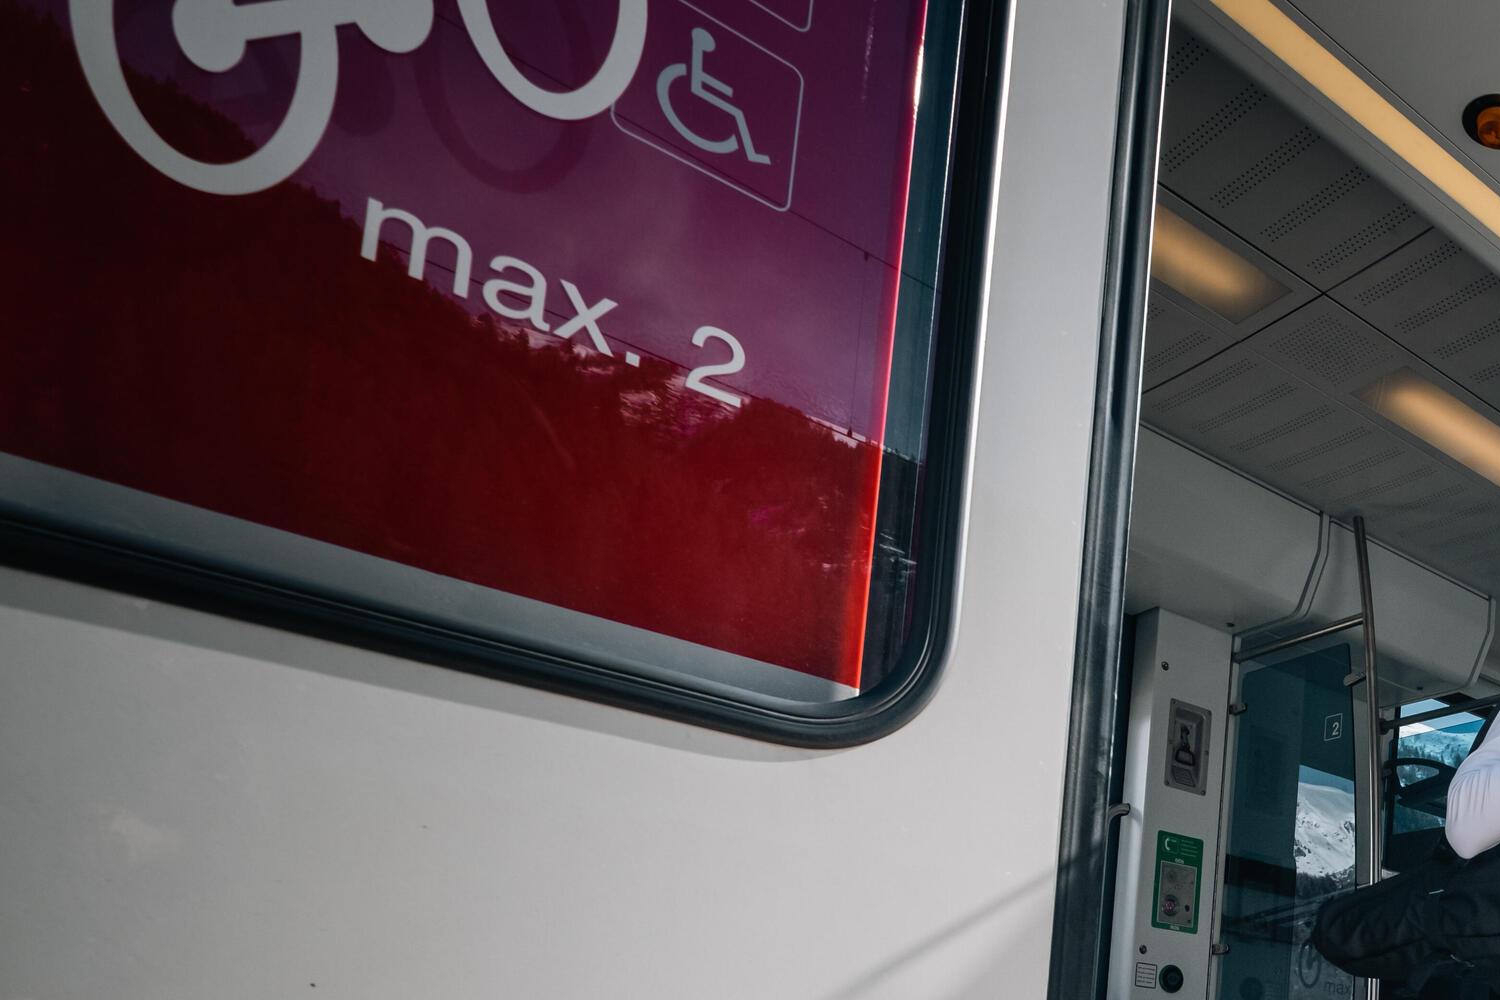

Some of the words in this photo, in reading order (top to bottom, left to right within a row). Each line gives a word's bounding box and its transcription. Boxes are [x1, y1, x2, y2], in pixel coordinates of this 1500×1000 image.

[360, 196, 641, 368] max.
[684, 325, 746, 408] 2
[1332, 721, 1340, 735] 2
